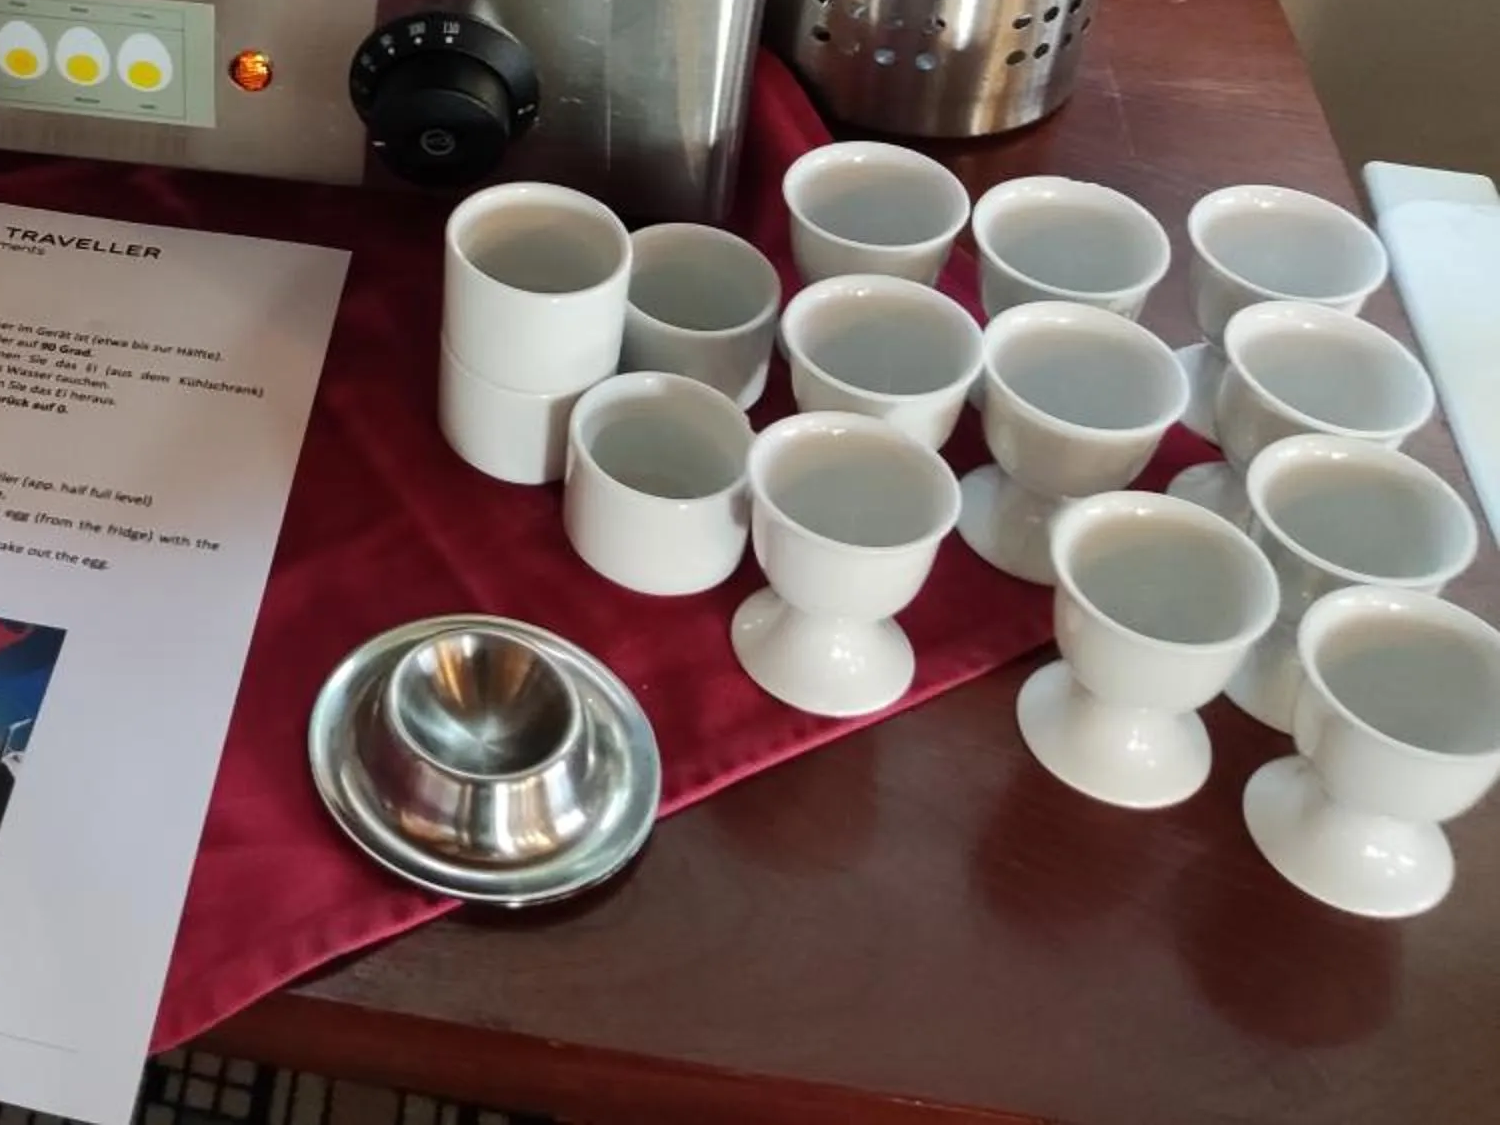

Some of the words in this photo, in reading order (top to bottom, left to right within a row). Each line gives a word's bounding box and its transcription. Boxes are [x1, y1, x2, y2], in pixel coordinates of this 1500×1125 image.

[4, 225, 163, 261] TRAVELLER
[16, 340, 39, 348] auf
[41, 342, 57, 352] 90
[7, 365, 52, 379] Wasser
[29, 355, 47, 365] Sie
[55, 359, 77, 370] das
[105, 366, 132, 378] (aus
[140, 371, 170, 382] dem
[179, 377, 264, 398] Kühlschrank)
[8, 380, 27, 391] Sie
[30, 385, 52, 395] das
[55, 388, 67, 397] Ei
[32, 403, 56, 411] auf
[57, 404, 68, 414] 0.
[60, 483, 88, 495] half
[90, 487, 112, 499] full
[5, 510, 30, 522] egg
[34, 512, 73, 528] (from
[79, 521, 102, 533] the
[107, 524, 154, 542] fridge)
[159, 535, 190, 546] with
[196, 539, 220, 551] the
[27, 548, 52, 558] out
[55, 551, 79, 564] the
